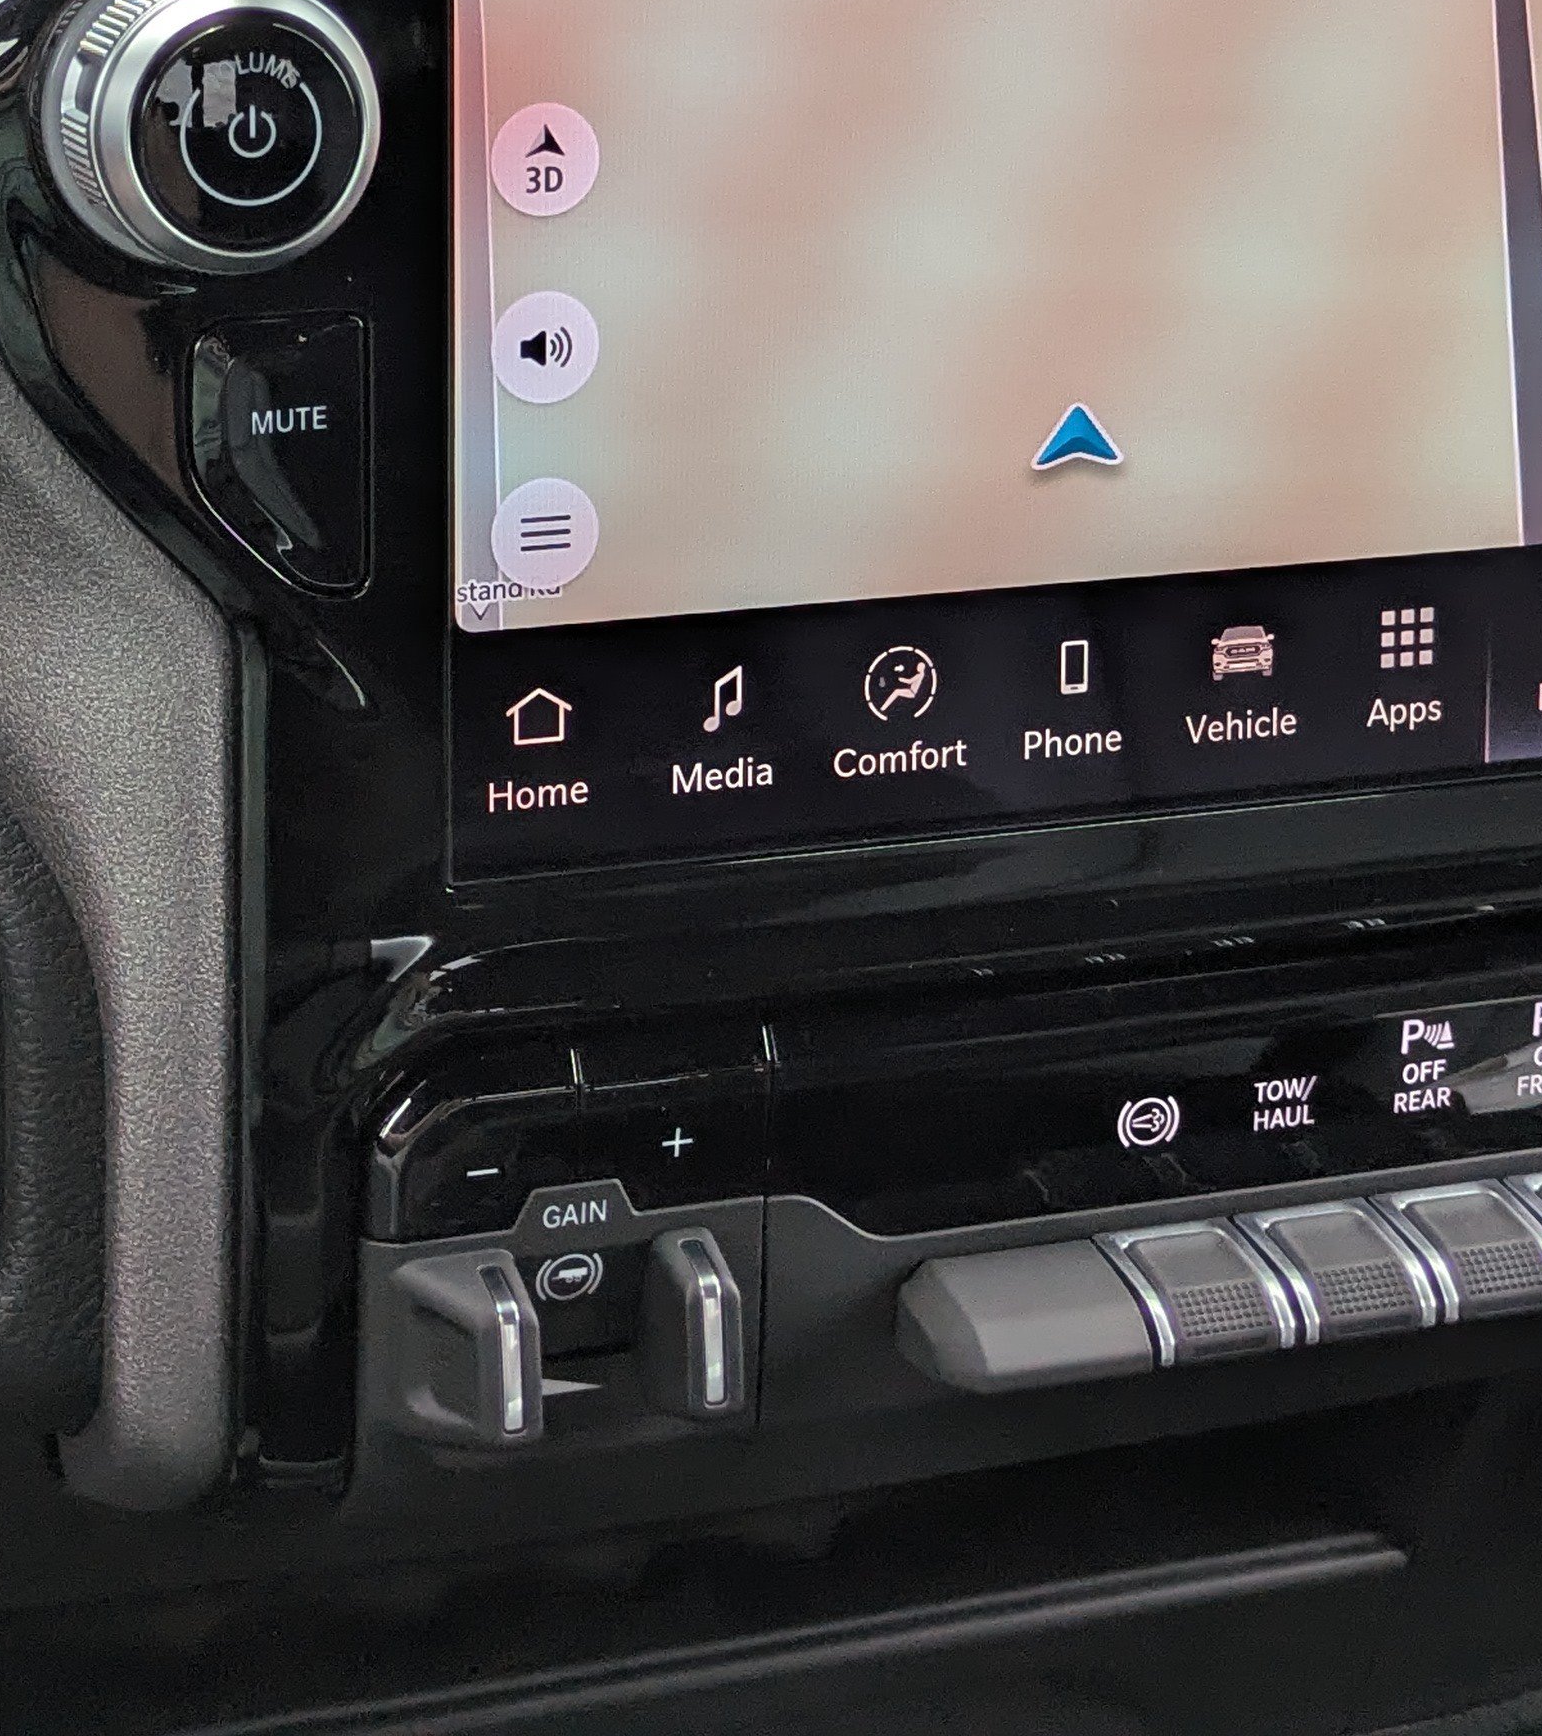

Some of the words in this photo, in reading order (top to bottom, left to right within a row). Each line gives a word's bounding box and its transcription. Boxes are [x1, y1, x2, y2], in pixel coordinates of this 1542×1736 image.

[525, 167, 563, 194] 3D
[251, 405, 328, 435] MUTE
[1185, 707, 1297, 745] Vehicle
[1366, 697, 1442, 733] Apps
[1023, 727, 1122, 760] Phone
[833, 740, 967, 778] Comfort
[672, 758, 774, 794] Media
[488, 778, 589, 813] Home
[1402, 1059, 1446, 1084] OFF
[1254, 1076, 1317, 1103] TOW/
[1393, 1087, 1451, 1114] REAR
[1253, 1104, 1315, 1132] HAUL
[542, 1199, 608, 1229] GAIN
